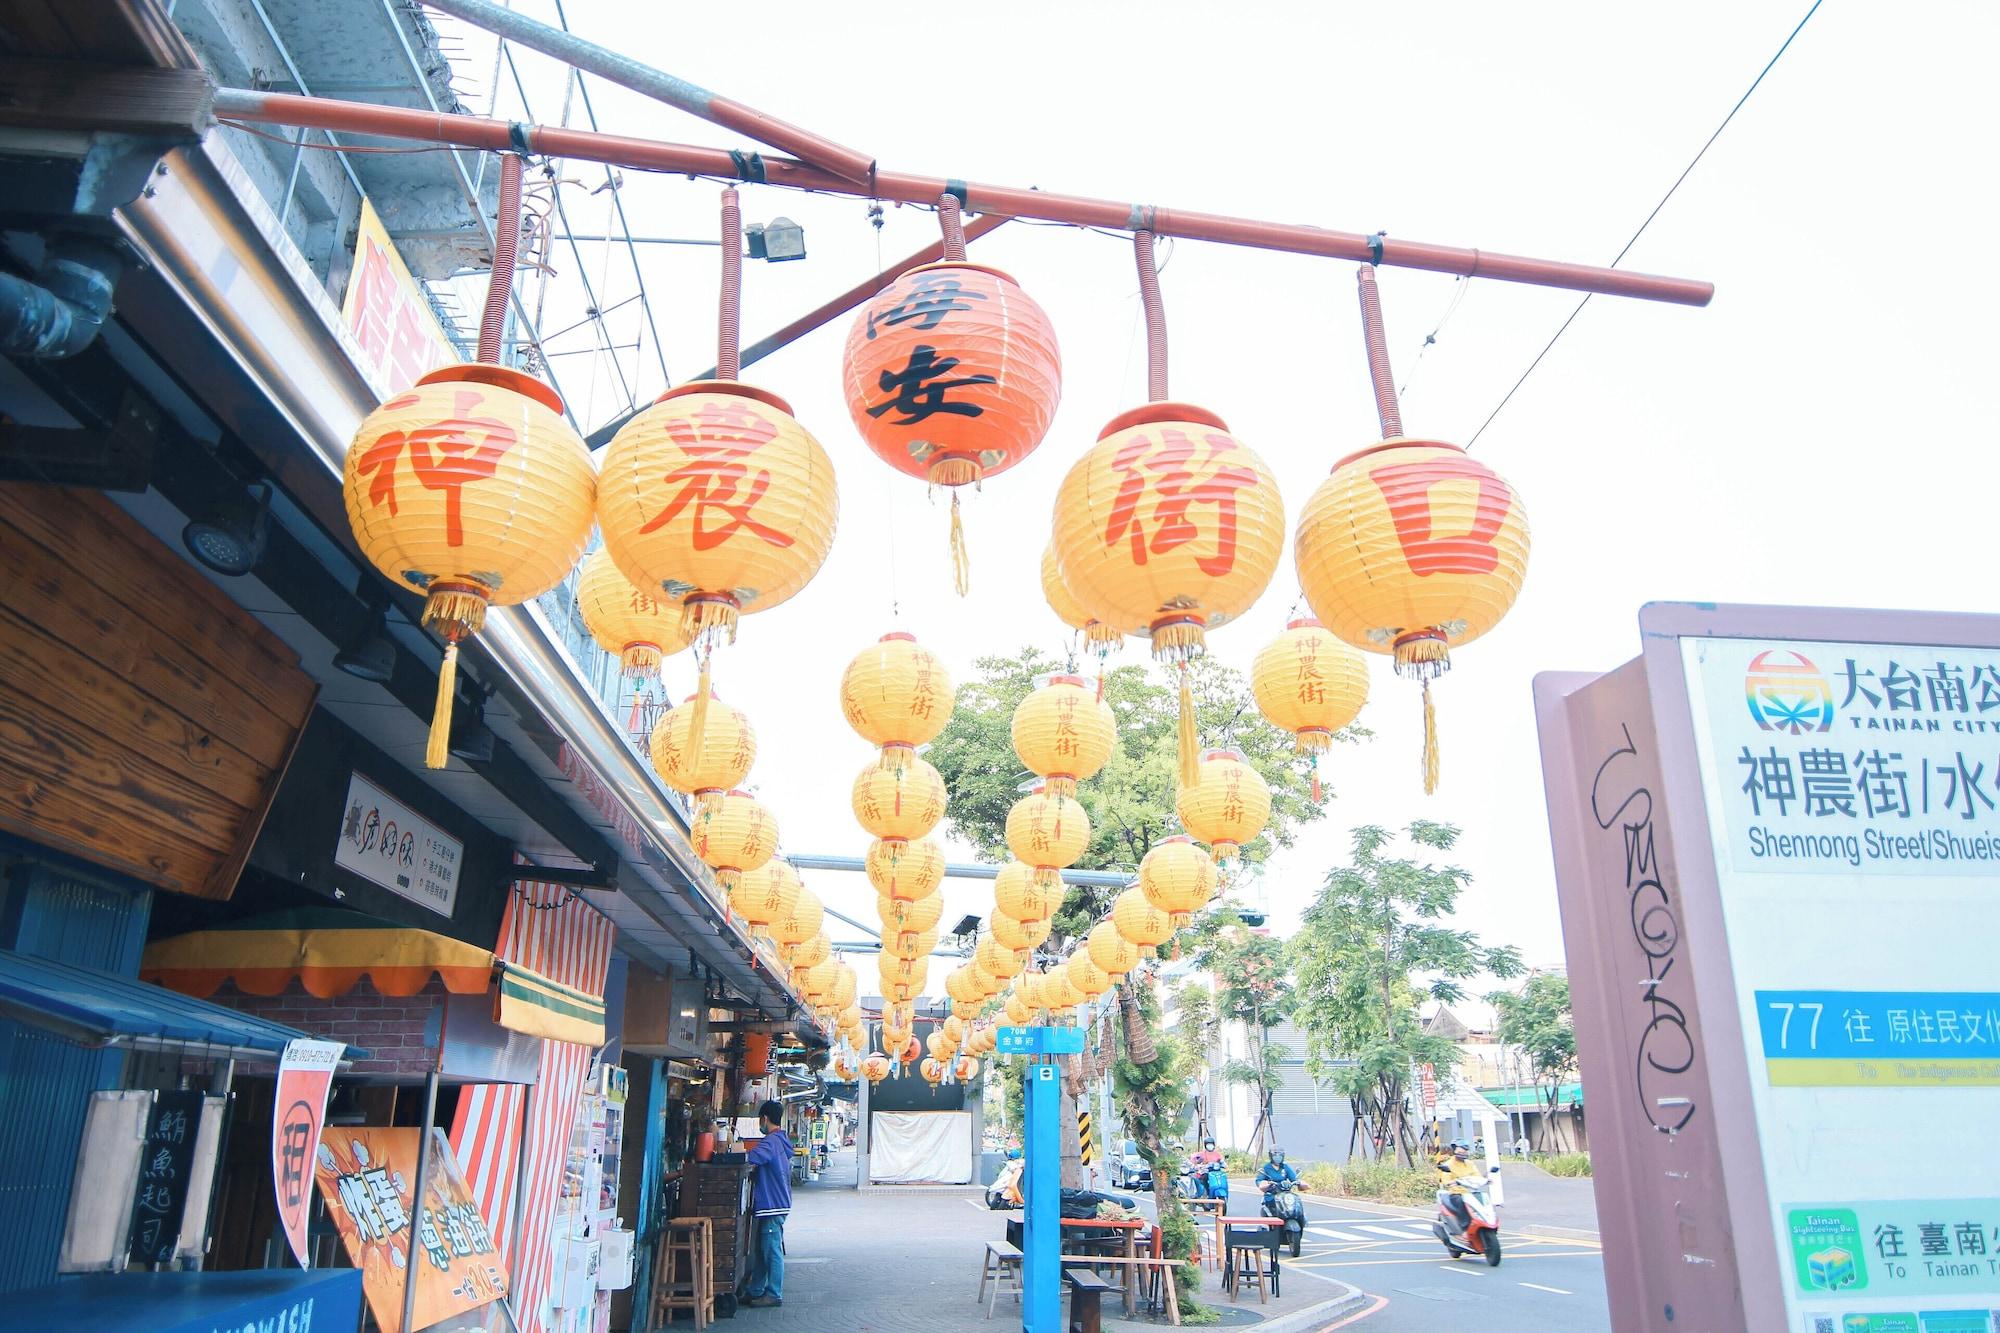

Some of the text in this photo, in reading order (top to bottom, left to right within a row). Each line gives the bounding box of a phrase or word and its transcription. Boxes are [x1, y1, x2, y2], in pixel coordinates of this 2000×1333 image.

[357, 391, 517, 547] 神
[638, 402, 796, 551] 農
[1105, 429, 1258, 577] 街
[909, 651, 934, 720] 神農街
[1293, 635, 1327, 705] 神農街
[1055, 695, 1079, 758] 神農街
[1850, 716, 2000, 734] TAINAN CITY
[1222, 767, 1245, 824] 神農街
[1028, 802, 1049, 853] 神農街
[1749, 826, 1860, 866] Shennong
[1769, 1003, 1823, 1049] 77
[1842, 1008, 1875, 1043] 往
[1856, 1063, 1878, 1078] To
[140, 1110, 187, 1253] 鮪魚起司
[282, 1122, 310, 1207] 租
[338, 1167, 410, 1243] 炸蛋
[1806, 1215, 1841, 1225] Tainan
[1839, 1224, 1856, 1233] Bus
[1873, 1224, 1907, 1259] 往
[1885, 1262, 1906, 1279] To
[1923, 1261, 1979, 1277] Tainan
